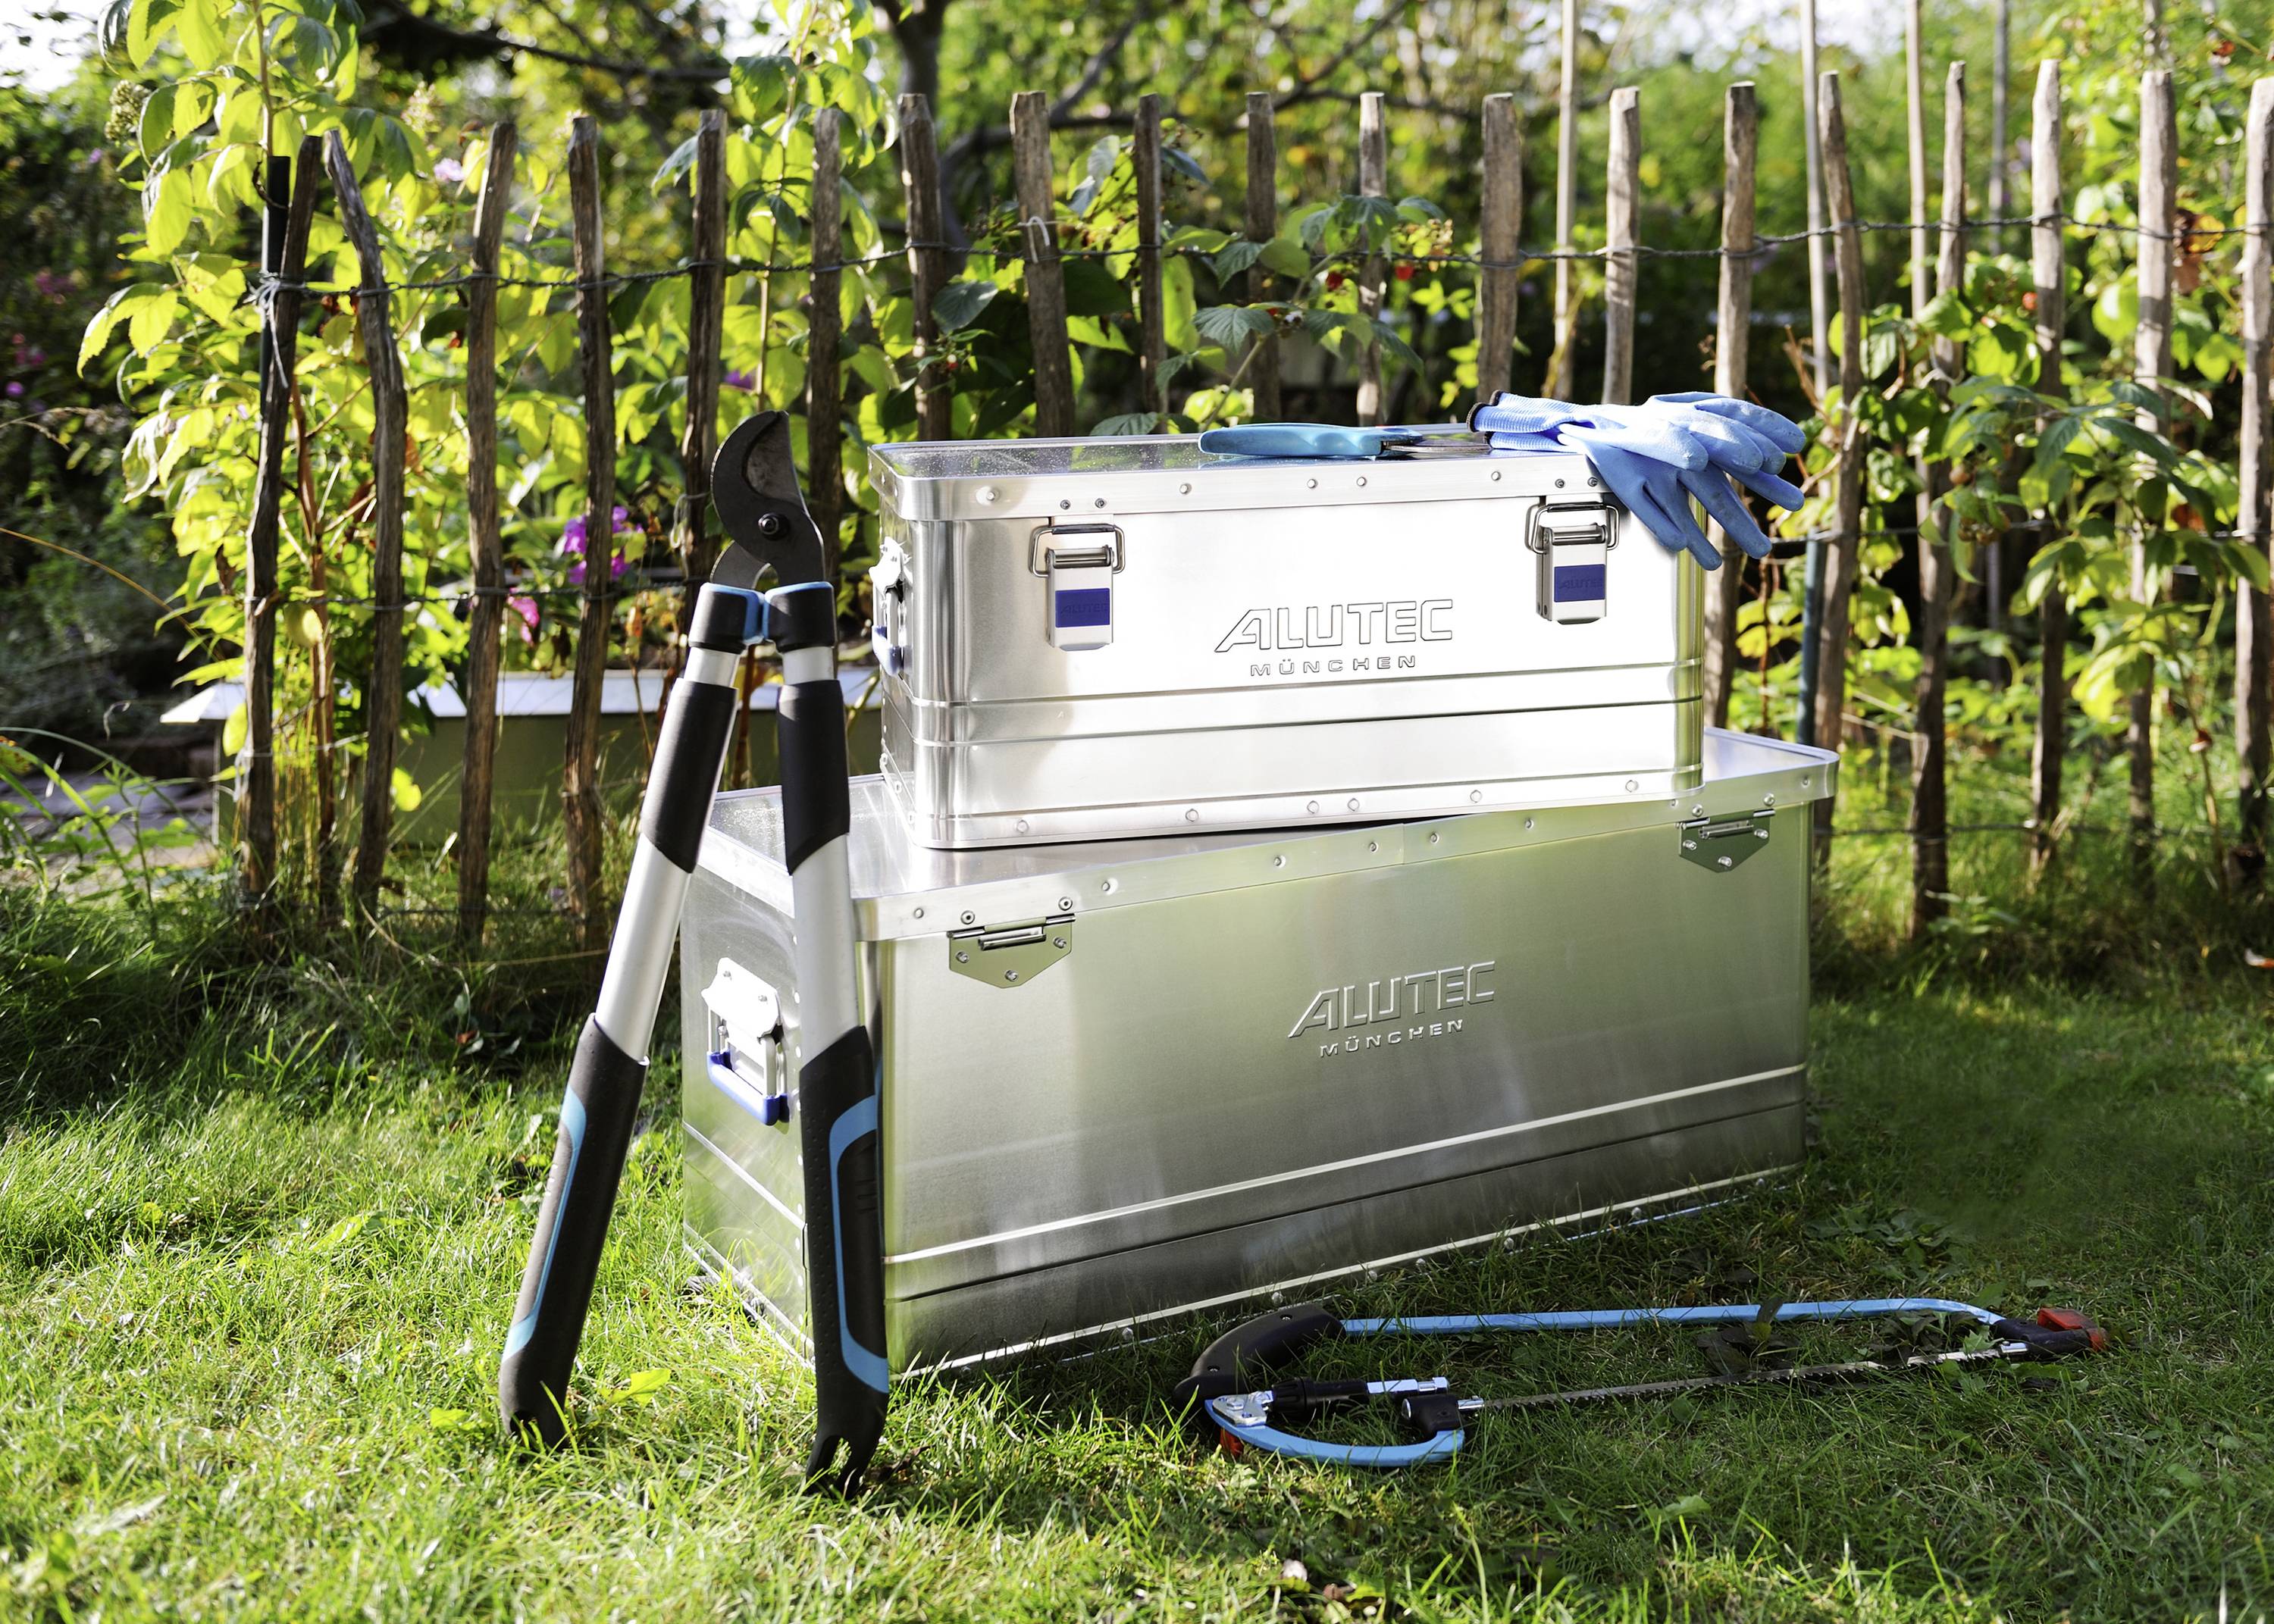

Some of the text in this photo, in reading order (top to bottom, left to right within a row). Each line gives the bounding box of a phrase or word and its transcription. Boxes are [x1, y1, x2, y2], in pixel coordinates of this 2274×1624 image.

[1214, 599, 1453, 653] ALUTEC
[1250, 656, 1416, 677] MÜNCHEN
[1288, 960, 1496, 1038] ALUTEC
[1320, 1018, 1464, 1058] MÜNCHEN
